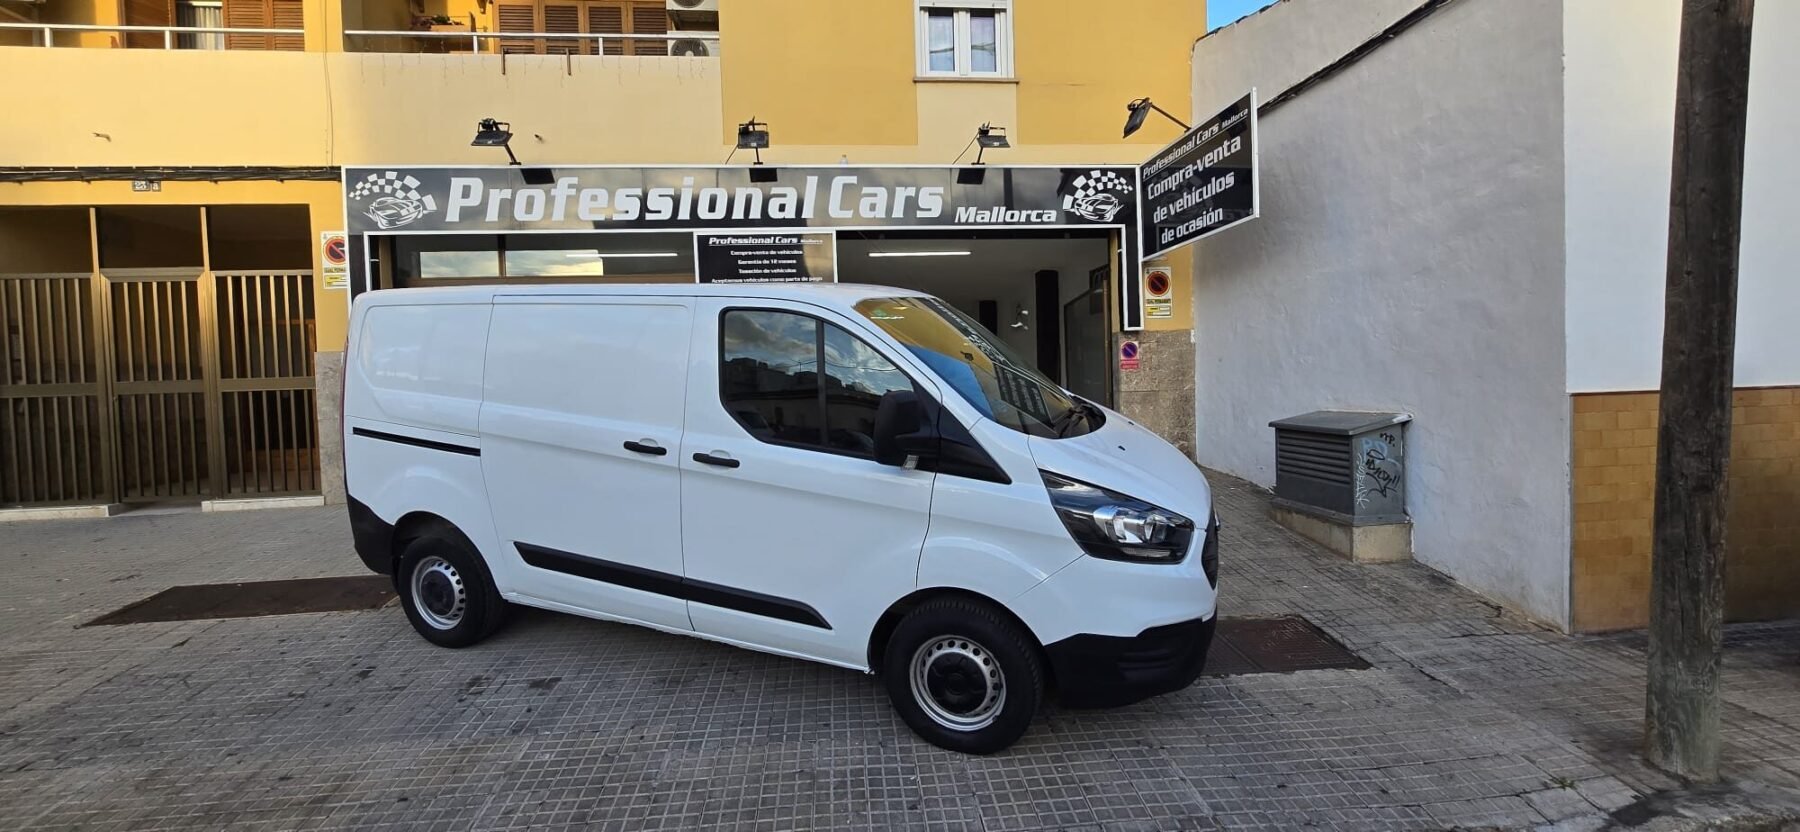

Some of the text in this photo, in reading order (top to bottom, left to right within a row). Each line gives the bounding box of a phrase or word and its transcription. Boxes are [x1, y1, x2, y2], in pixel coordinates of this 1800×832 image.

[1143, 109, 1248, 178] Professional Cars Mallorca
[1147, 136, 1241, 200] Compra-venta
[445, 175, 1057, 223] Professional Cars Mallorca
[1153, 171, 1235, 224] de vehículos
[709, 236, 774, 245] Professional
[775, 236, 798, 244] Cars
[1161, 207, 1224, 244] de ocasión
